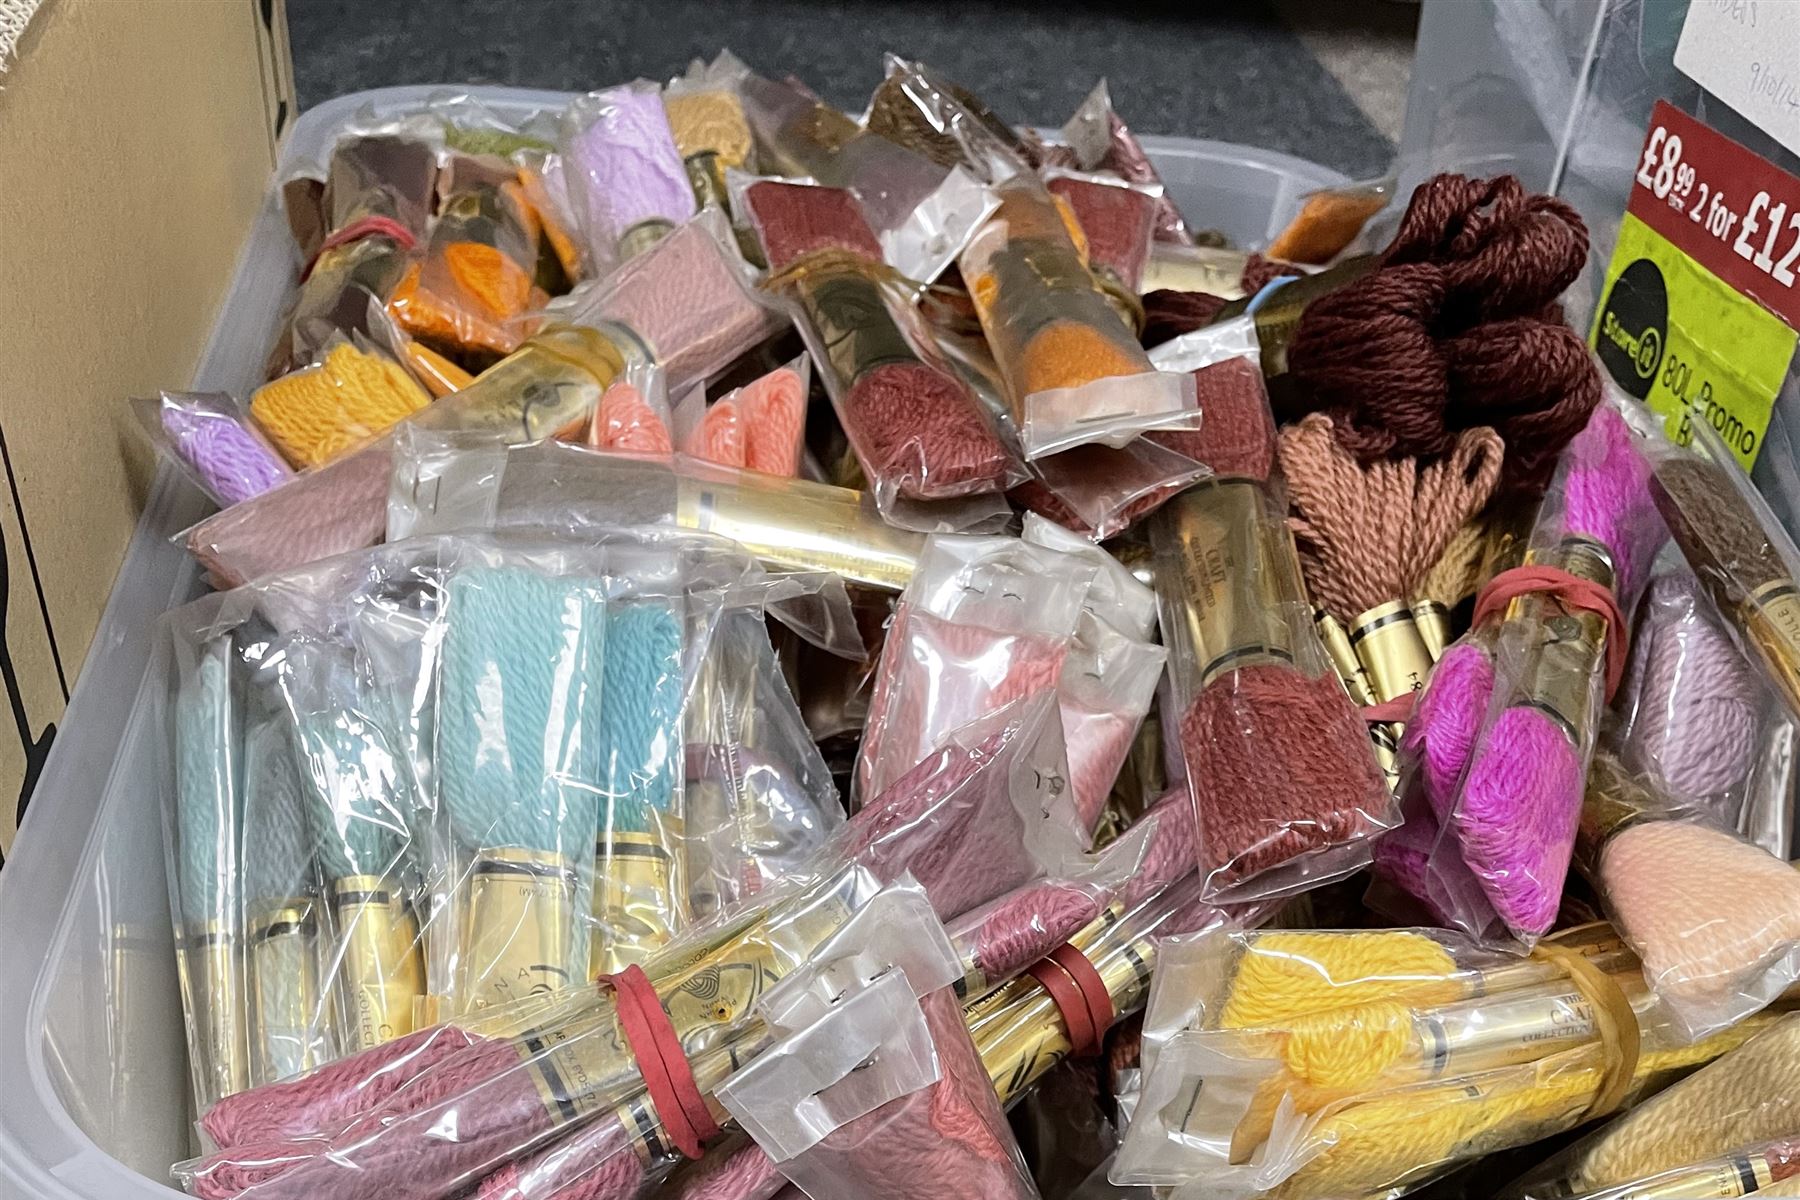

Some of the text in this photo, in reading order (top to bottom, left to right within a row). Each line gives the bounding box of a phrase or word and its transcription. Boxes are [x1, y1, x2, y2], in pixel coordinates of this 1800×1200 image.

[1688, 182, 1709, 223] 2
[1705, 191, 1738, 242] for
[1662, 354, 1693, 405] 80L
